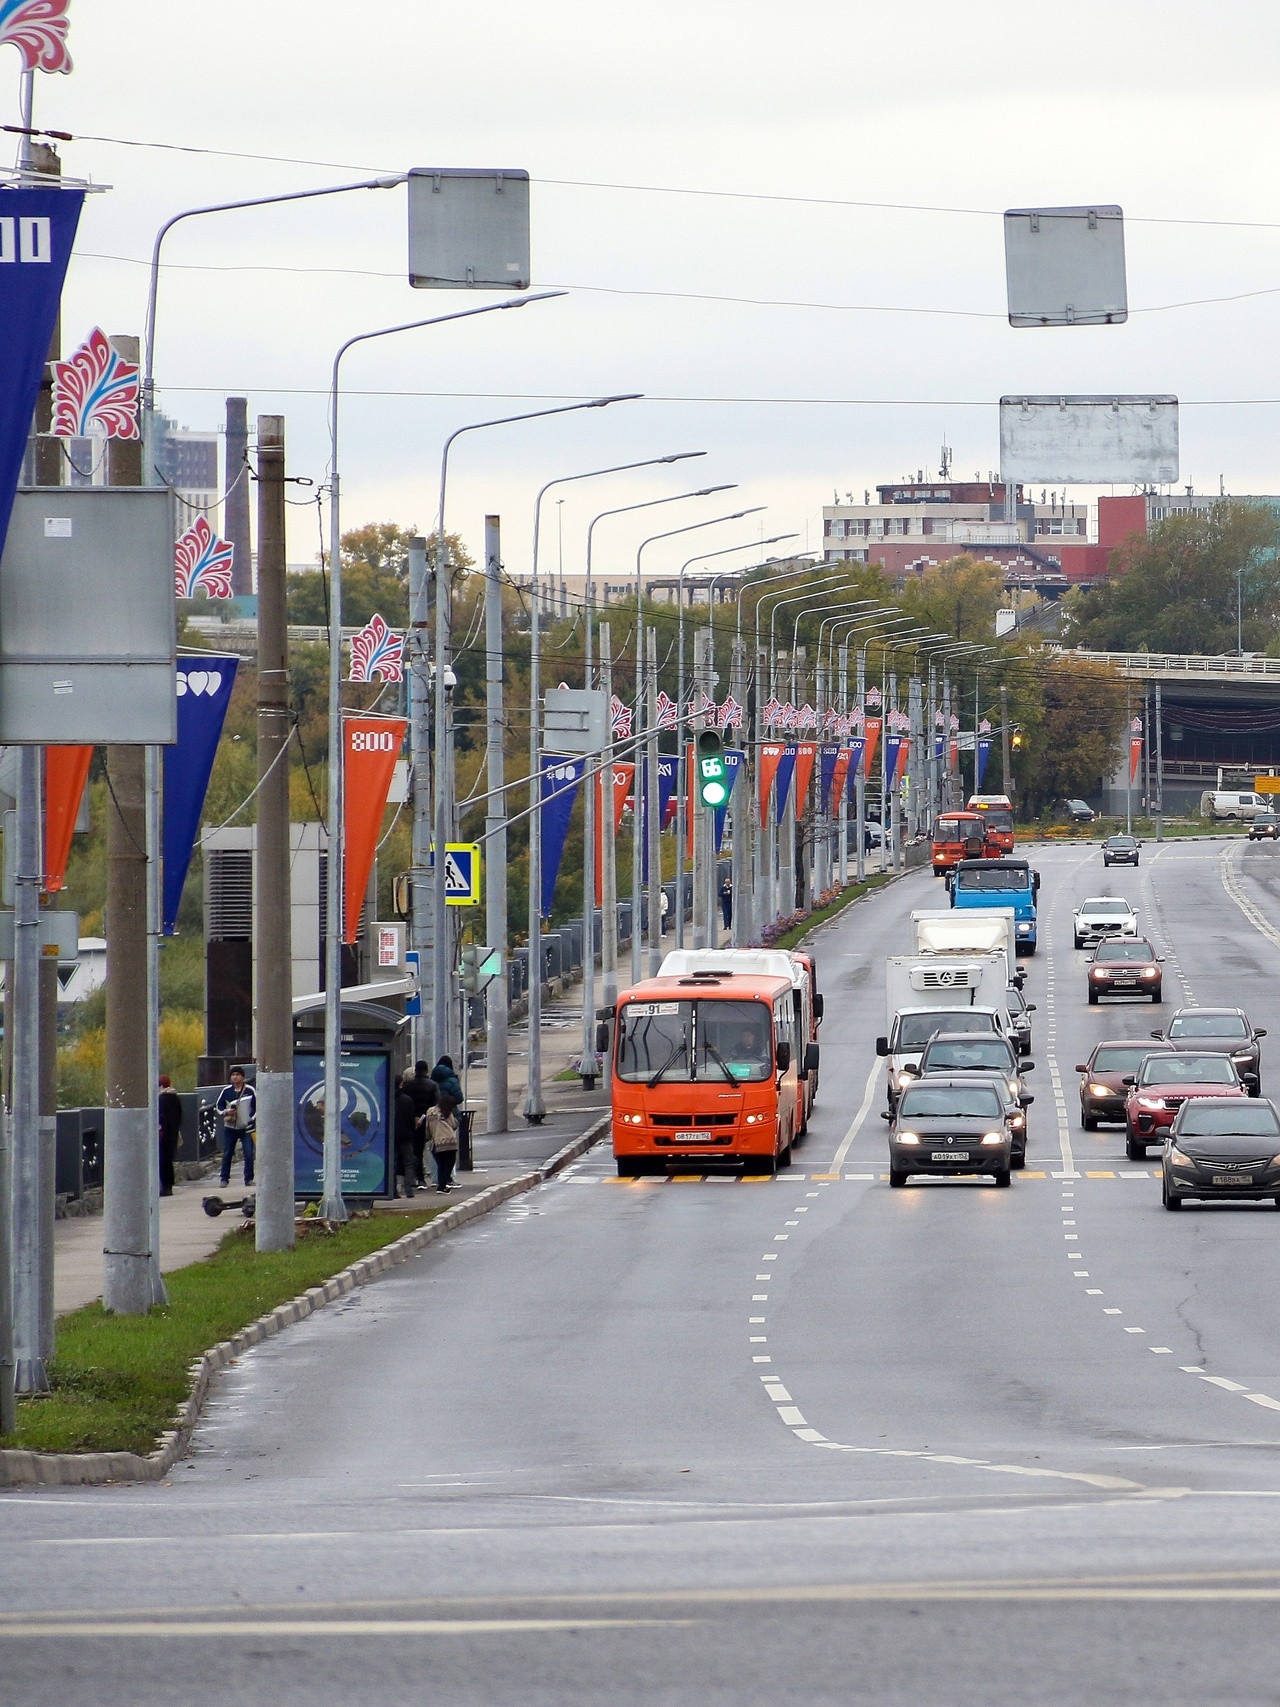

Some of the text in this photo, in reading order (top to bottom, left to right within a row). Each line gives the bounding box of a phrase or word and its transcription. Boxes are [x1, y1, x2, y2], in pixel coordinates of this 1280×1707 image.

[351, 731, 393, 752] 800
[798, 747, 812, 755] 800
[702, 758, 723, 778] 66
